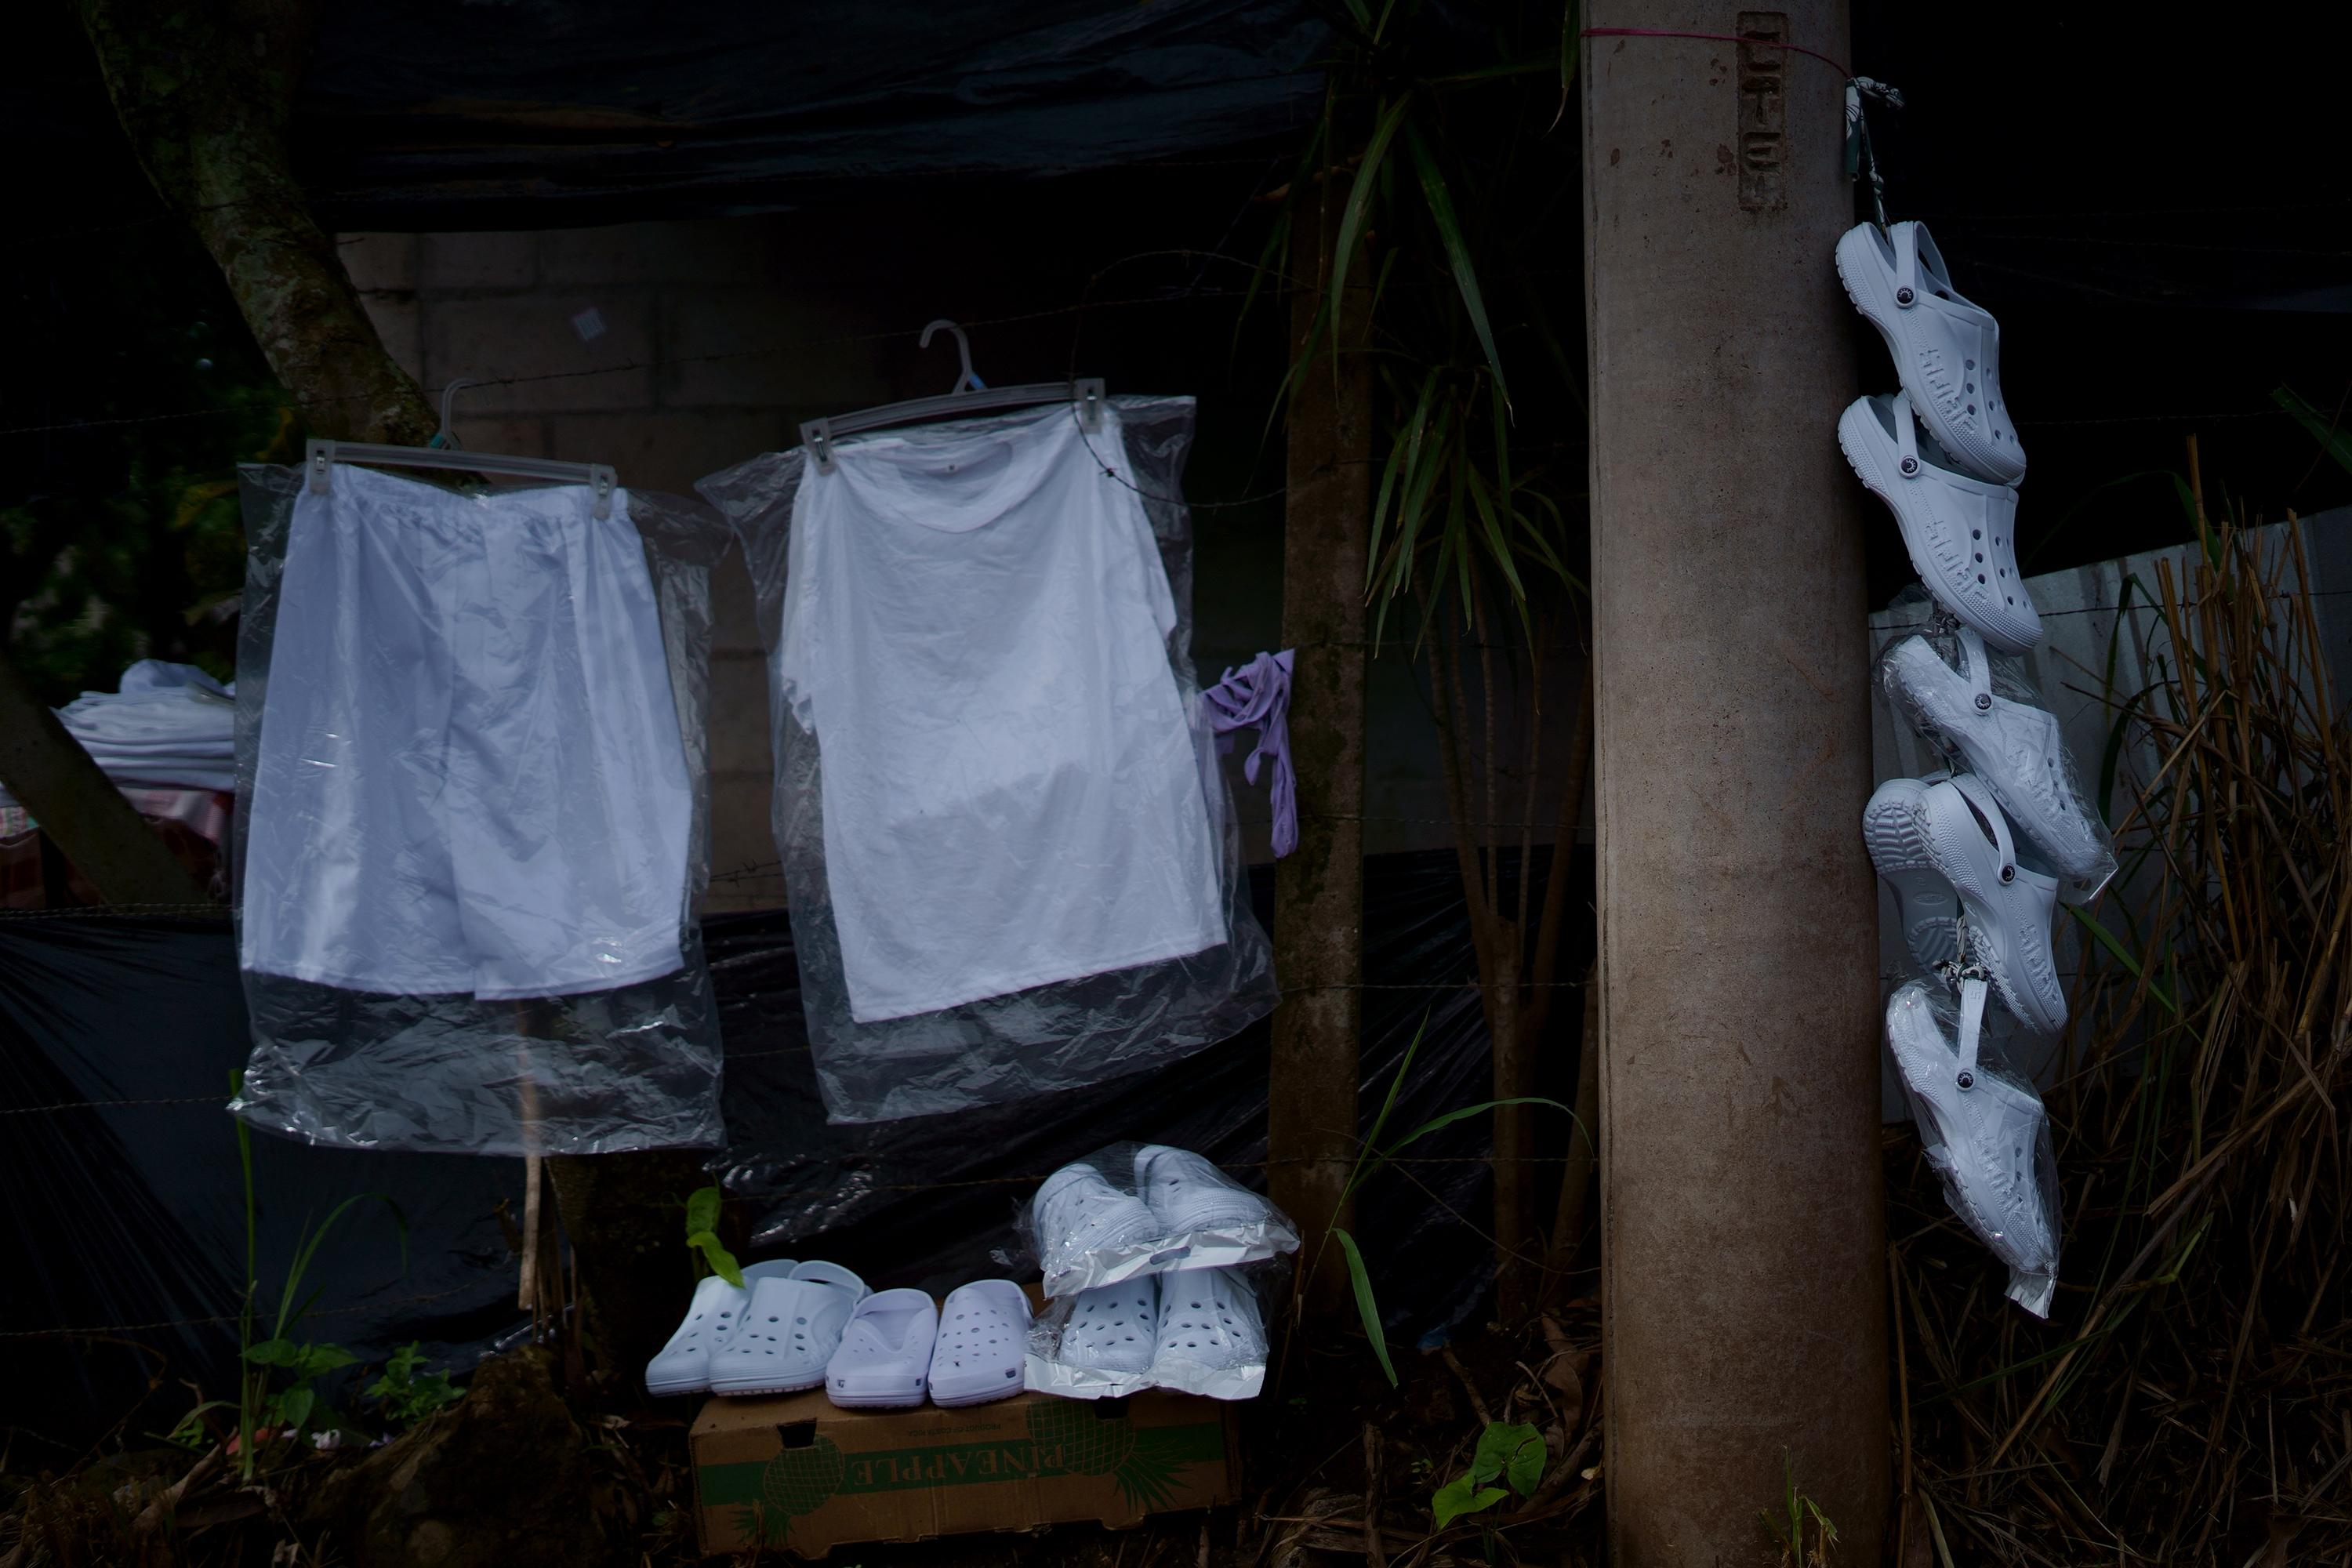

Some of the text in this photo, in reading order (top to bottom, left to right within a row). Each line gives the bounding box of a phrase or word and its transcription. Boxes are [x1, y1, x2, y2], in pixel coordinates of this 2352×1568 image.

[927, 1427, 952, 1436] COSTA
[965, 1423, 1001, 1432] PRODUCT
[852, 1443, 1064, 1486] PINEAPPLE
